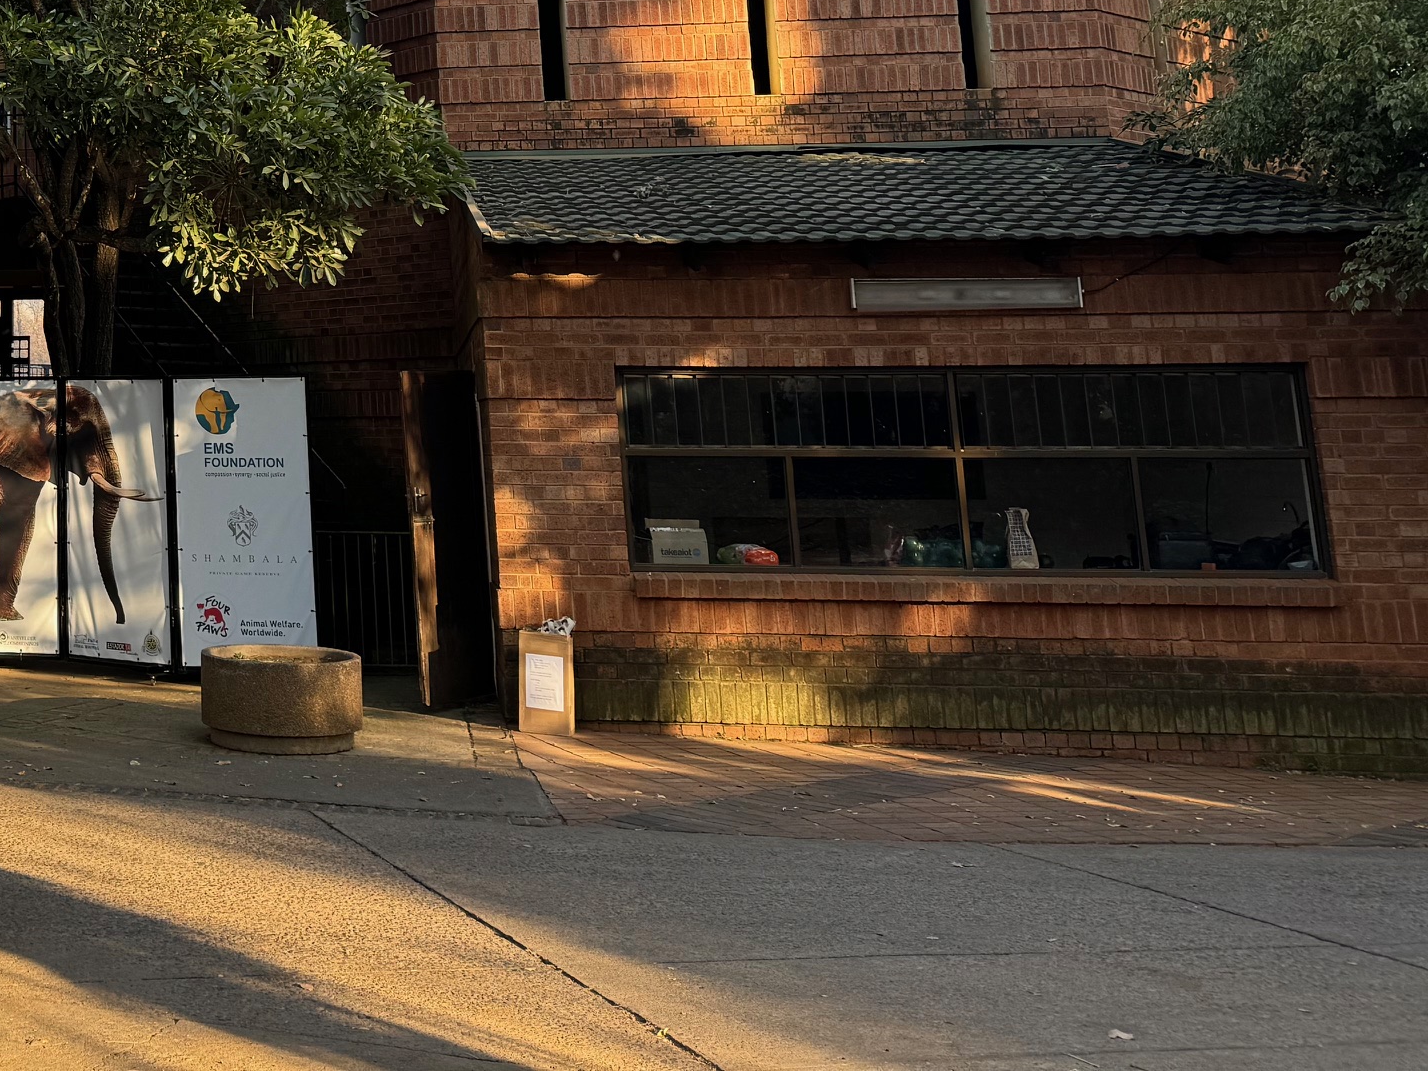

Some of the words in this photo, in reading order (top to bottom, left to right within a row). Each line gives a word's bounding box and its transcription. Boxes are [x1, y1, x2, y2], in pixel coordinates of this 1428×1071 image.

[204, 442, 234, 454] EMS
[204, 457, 284, 468] FOUNDATION
[191, 553, 298, 564] SHAMBALA
[205, 595, 231, 616] FOUR
[195, 621, 229, 638] PAWS
[240, 619, 268, 628] Animal
[269, 620, 303, 629] Welfare.
[240, 628, 286, 637] Worldwide.
